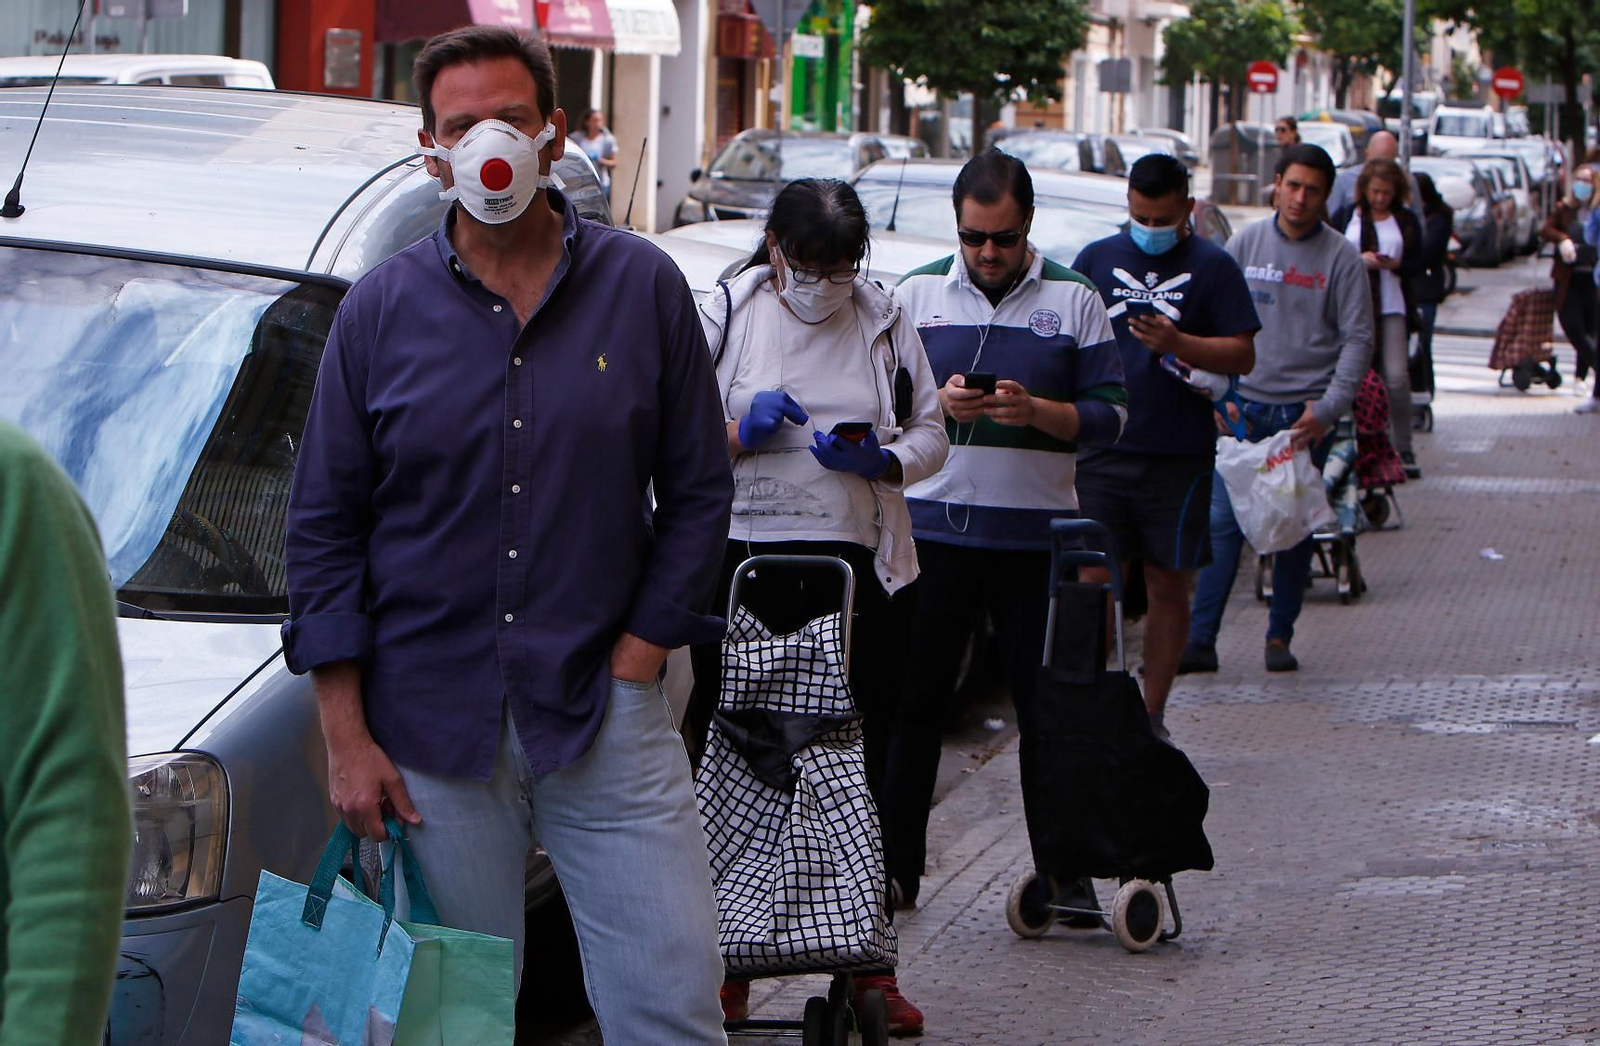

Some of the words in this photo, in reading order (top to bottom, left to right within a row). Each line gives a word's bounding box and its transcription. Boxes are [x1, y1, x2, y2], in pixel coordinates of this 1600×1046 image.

[1245, 263, 1284, 282] make
[1285, 265, 1325, 289] don't
[1112, 288, 1184, 301] SCOTLAND
